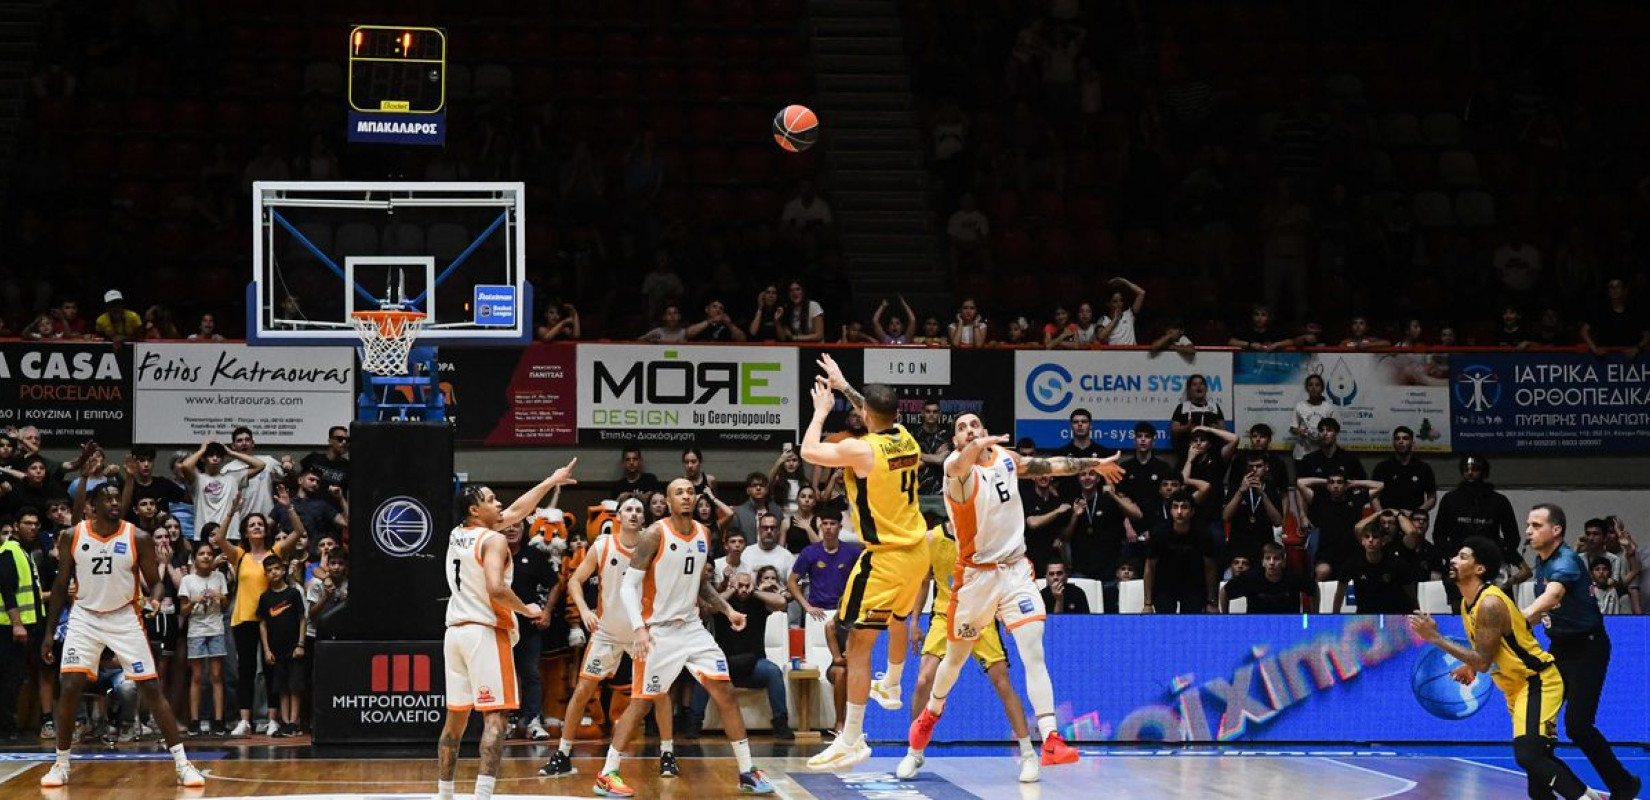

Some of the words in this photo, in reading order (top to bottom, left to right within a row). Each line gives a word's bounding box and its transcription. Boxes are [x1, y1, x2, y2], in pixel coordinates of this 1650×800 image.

[357, 120, 437, 135] ΜΠΑΚΑΛΑΡΟΣ
[20, 351, 122, 380] CASA
[209, 350, 349, 386] Katraouras
[1514, 364, 1599, 384] ΙΑΤΡΙΚΑ
[1080, 374, 1140, 391] CLEAN
[1147, 374, 1222, 393] SYSM
[20, 385, 122, 401] PORCELANA
[184, 394, 303, 410] www.katraouras.com
[25, 409, 72, 419] ΚΟΥΖΙΝΑ
[84, 410, 123, 419] ΕΠΙΠΛΟ
[593, 409, 678, 425] DESIGN
[693, 410, 705, 426] by
[708, 410, 781, 426] Georgiopoulos
[1514, 413, 1577, 426] ΠΥΡΠΙΡΗΣ
[901, 467, 916, 505] 4
[993, 482, 1008, 503] 6
[92, 556, 113, 575] 23
[683, 556, 695, 575] 0
[332, 694, 445, 709] ΜΗΤΡΟΠΟΛΙΤΙ
[361, 709, 441, 724] ΚΟΛΛΕΓΙΟ
